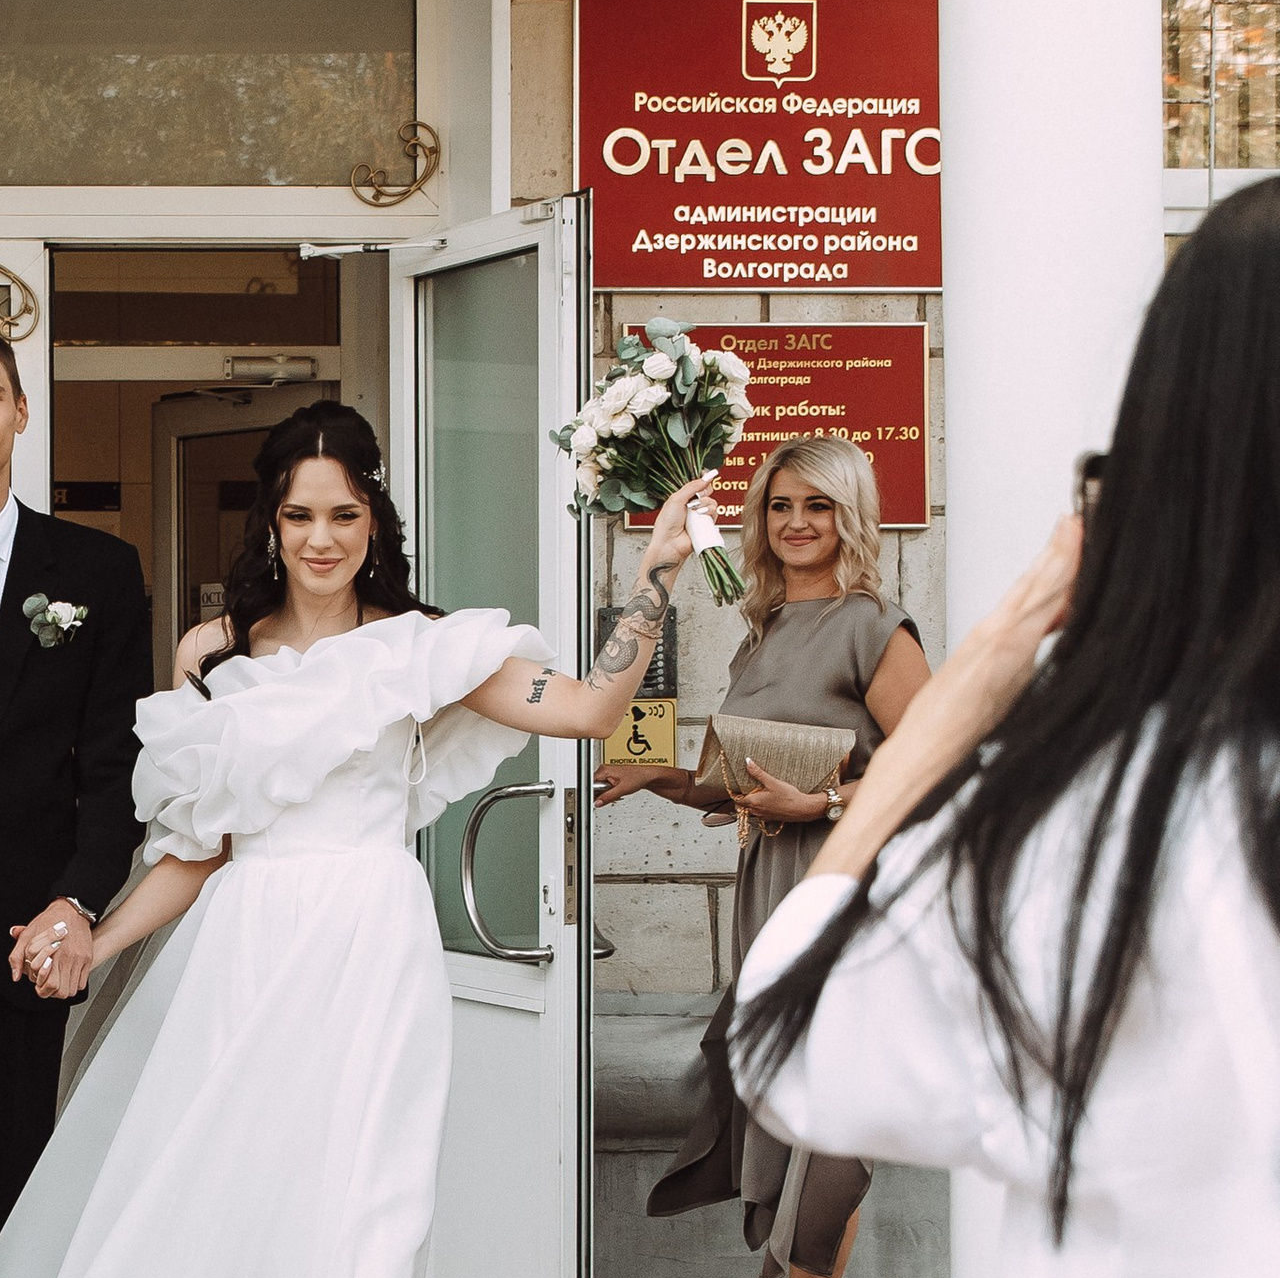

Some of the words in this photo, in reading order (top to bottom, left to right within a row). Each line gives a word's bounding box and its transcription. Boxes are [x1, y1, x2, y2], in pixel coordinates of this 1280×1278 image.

[634, 92, 777, 114] Российская
[782, 92, 920, 118] Федерация
[602, 127, 789, 183] Отдел
[803, 127, 942, 176] ЗАГС
[673, 204, 877, 227] администрации
[631, 230, 819, 254] Дзержинского
[824, 231, 918, 253] района
[702, 258, 849, 283] Волгограда
[720, 333, 779, 353] Отдел
[784, 333, 833, 351] ЗАГС
[757, 357, 844, 372] Дзержинского
[846, 358, 892, 371] района
[748, 375, 811, 387] олгограда
[775, 400, 846, 420] работы:
[814, 426, 848, 440] 830
[851, 430, 872, 443] до
[876, 426, 920, 441] 17.30
[712, 477, 749, 491] бота
